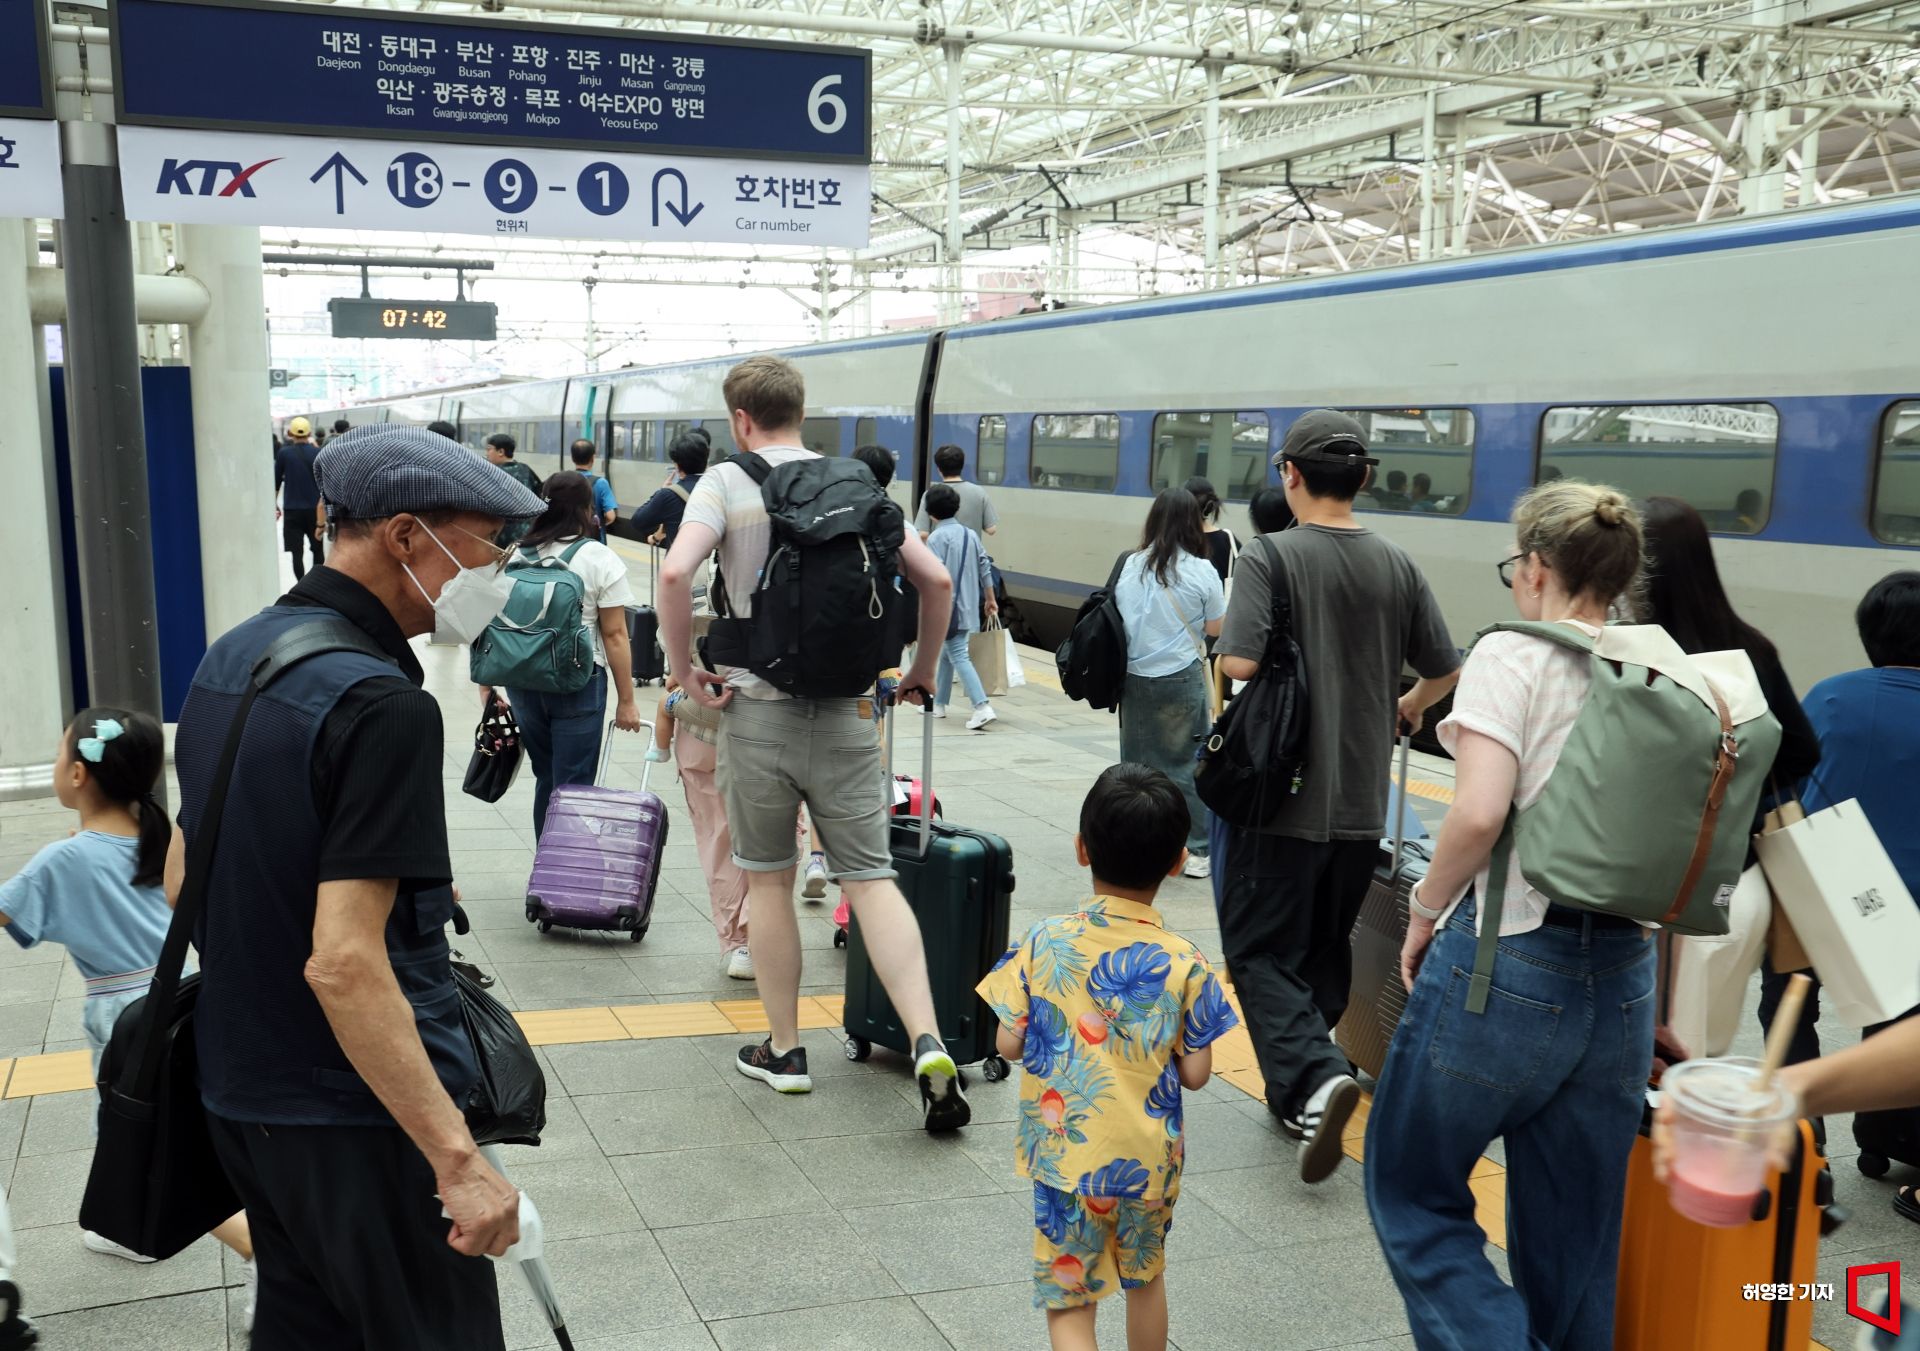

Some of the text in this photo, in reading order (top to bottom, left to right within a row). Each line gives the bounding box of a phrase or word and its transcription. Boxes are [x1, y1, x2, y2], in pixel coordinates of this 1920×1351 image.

[322, 30, 705, 79] 대전 동대구 부산 포항 진주 마산 강릉
[317, 55, 706, 95] Daejeon Dongdaegu Busan Pohang Jinju Masan Gangneung
[376, 77, 705, 119] 익산 광주송정 목포 여수EXPO 방면
[807, 74, 848, 134] 6
[386, 104, 415, 117] Iksan
[525, 112, 561, 127] Mokpo
[600, 117, 632, 130] Yeosu
[632, 119, 659, 133] Expo
[156, 156, 283, 199] KTX
[389, 162, 610, 210] 18 9 1
[735, 174, 842, 210] 호차번호
[496, 219, 528, 232] 현위치
[735, 216, 811, 233] Car number
[382, 309, 447, 329] 07:42
